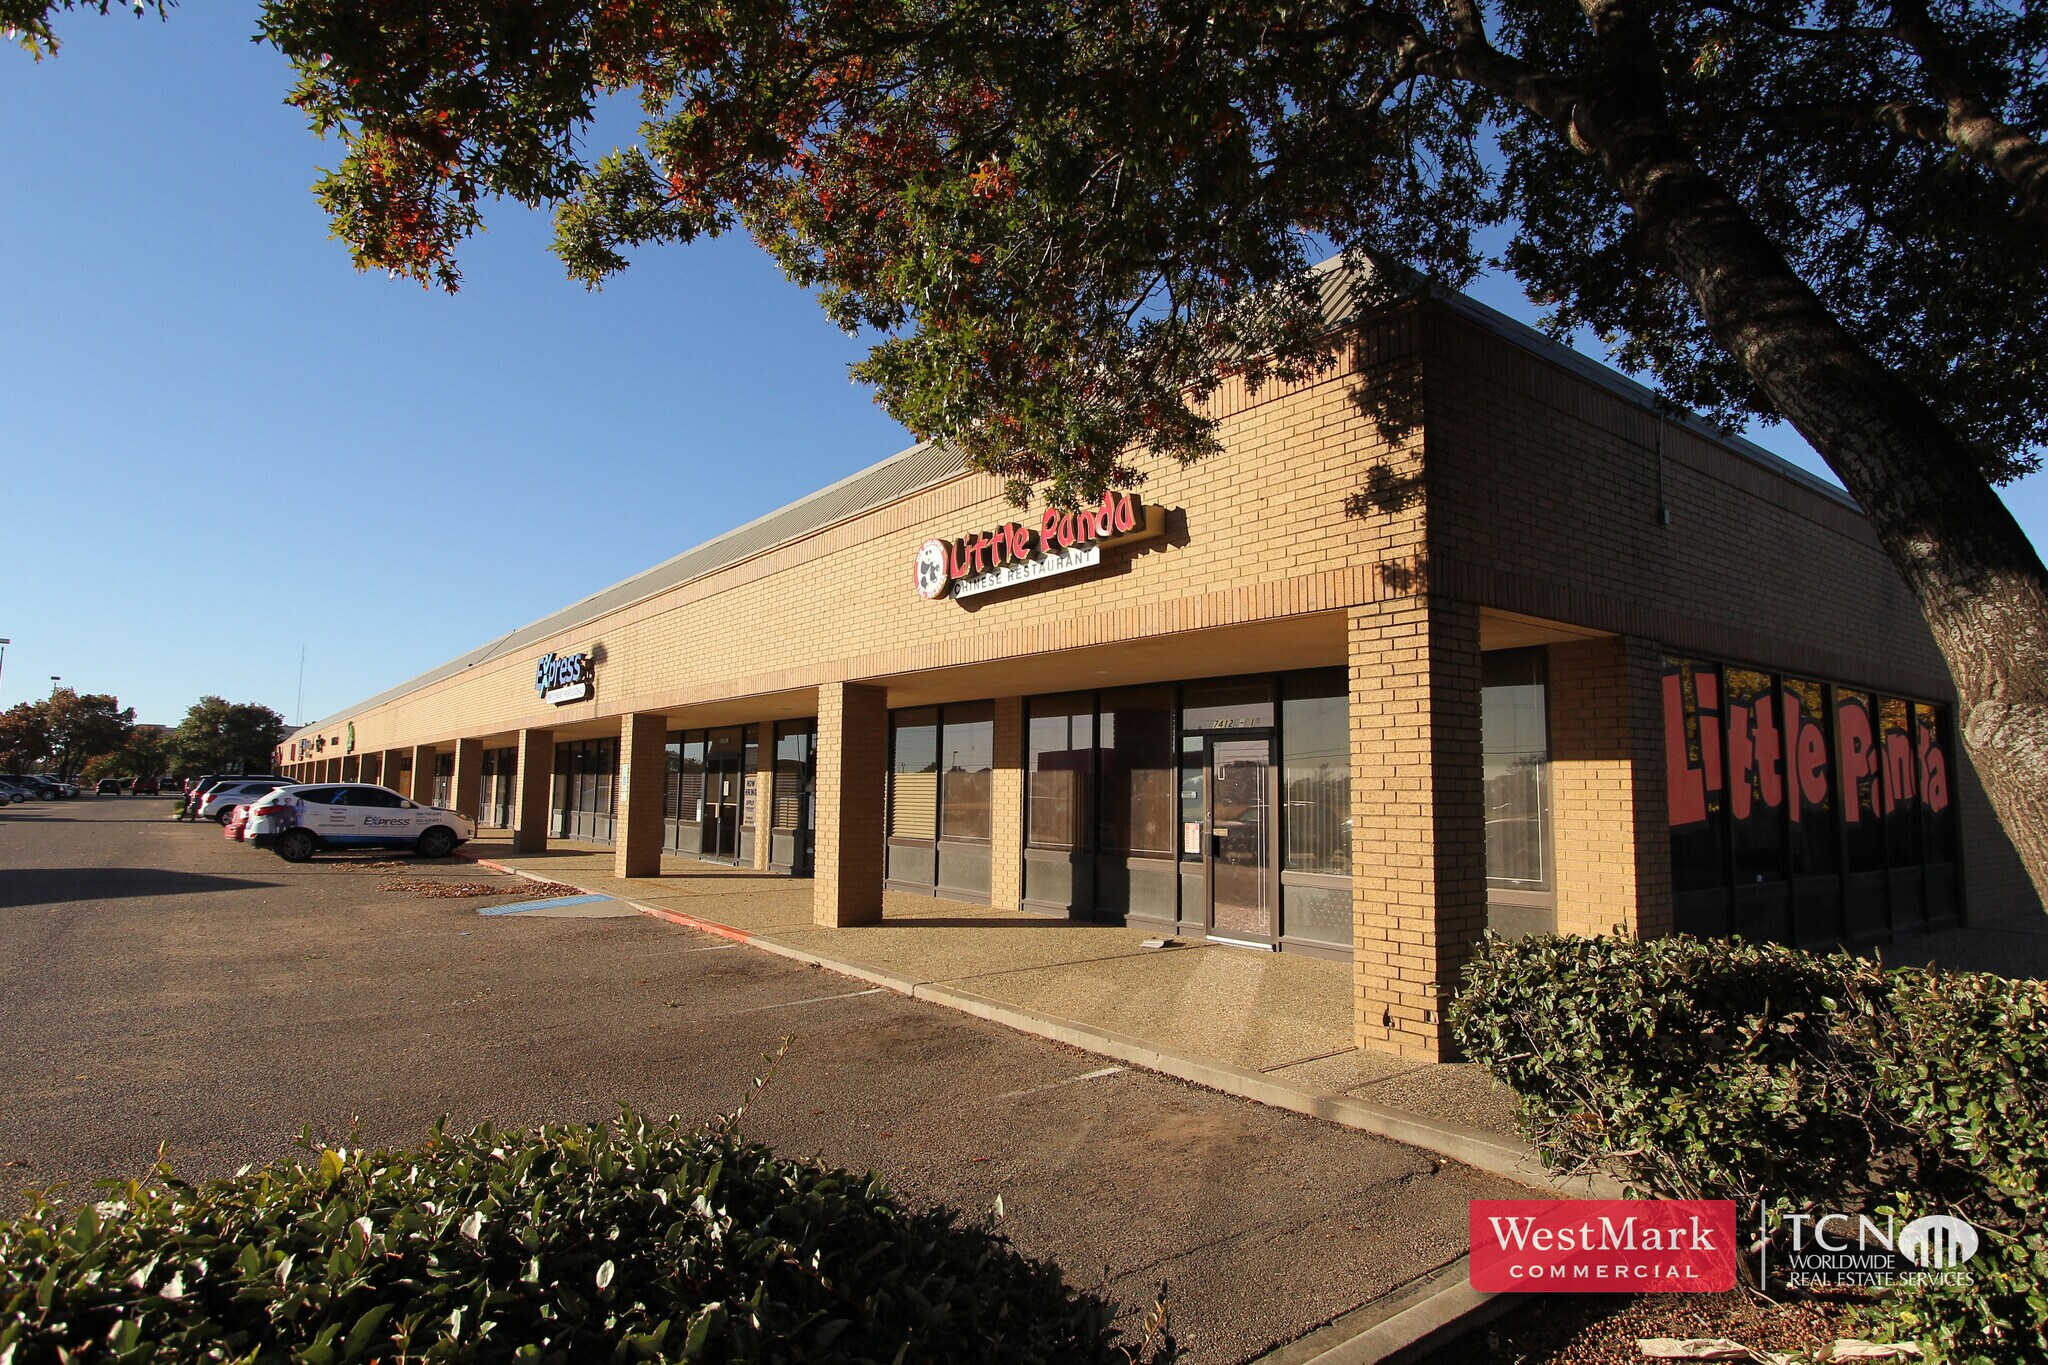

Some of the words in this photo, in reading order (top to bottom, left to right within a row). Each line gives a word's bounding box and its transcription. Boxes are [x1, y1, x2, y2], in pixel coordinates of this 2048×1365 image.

[951, 522, 1030, 579] Little
[1041, 490, 1137, 554] Panda
[954, 571, 1002, 595] CHINESE
[1008, 550, 1092, 581] RESTAURANT
[1213, 719, 1234, 728] 7412
[1662, 672, 1828, 826] Little
